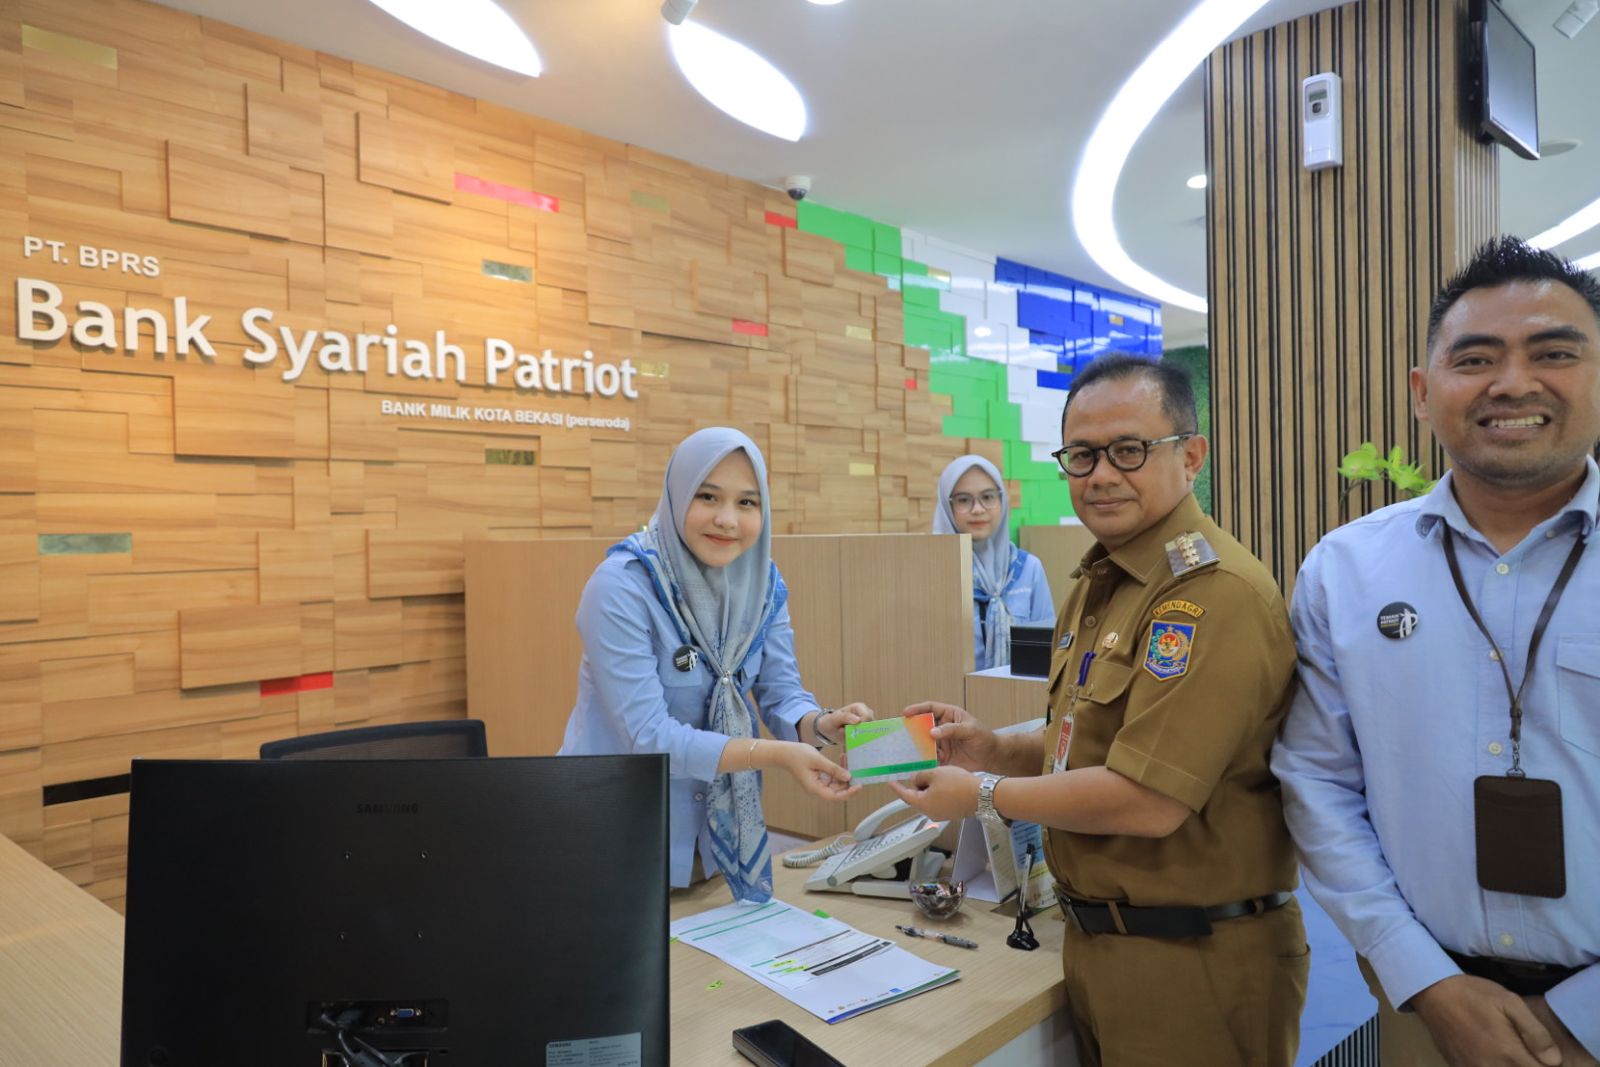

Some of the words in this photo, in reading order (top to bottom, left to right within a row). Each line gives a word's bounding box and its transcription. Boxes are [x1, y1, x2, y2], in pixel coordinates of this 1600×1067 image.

[23, 236, 69, 264] PT.
[79, 245, 160, 276] BPRS
[16, 277, 218, 356] Bank
[241, 307, 467, 381] Syariah
[485, 338, 639, 398] Patriot
[382, 400, 427, 417] BANK
[430, 403, 470, 420] MILIK
[474, 406, 513, 423] KOTA
[515, 409, 563, 426] BEKASI
[565, 413, 631, 431] (perseroda)
[356, 803, 420, 814] SAMSUNG
